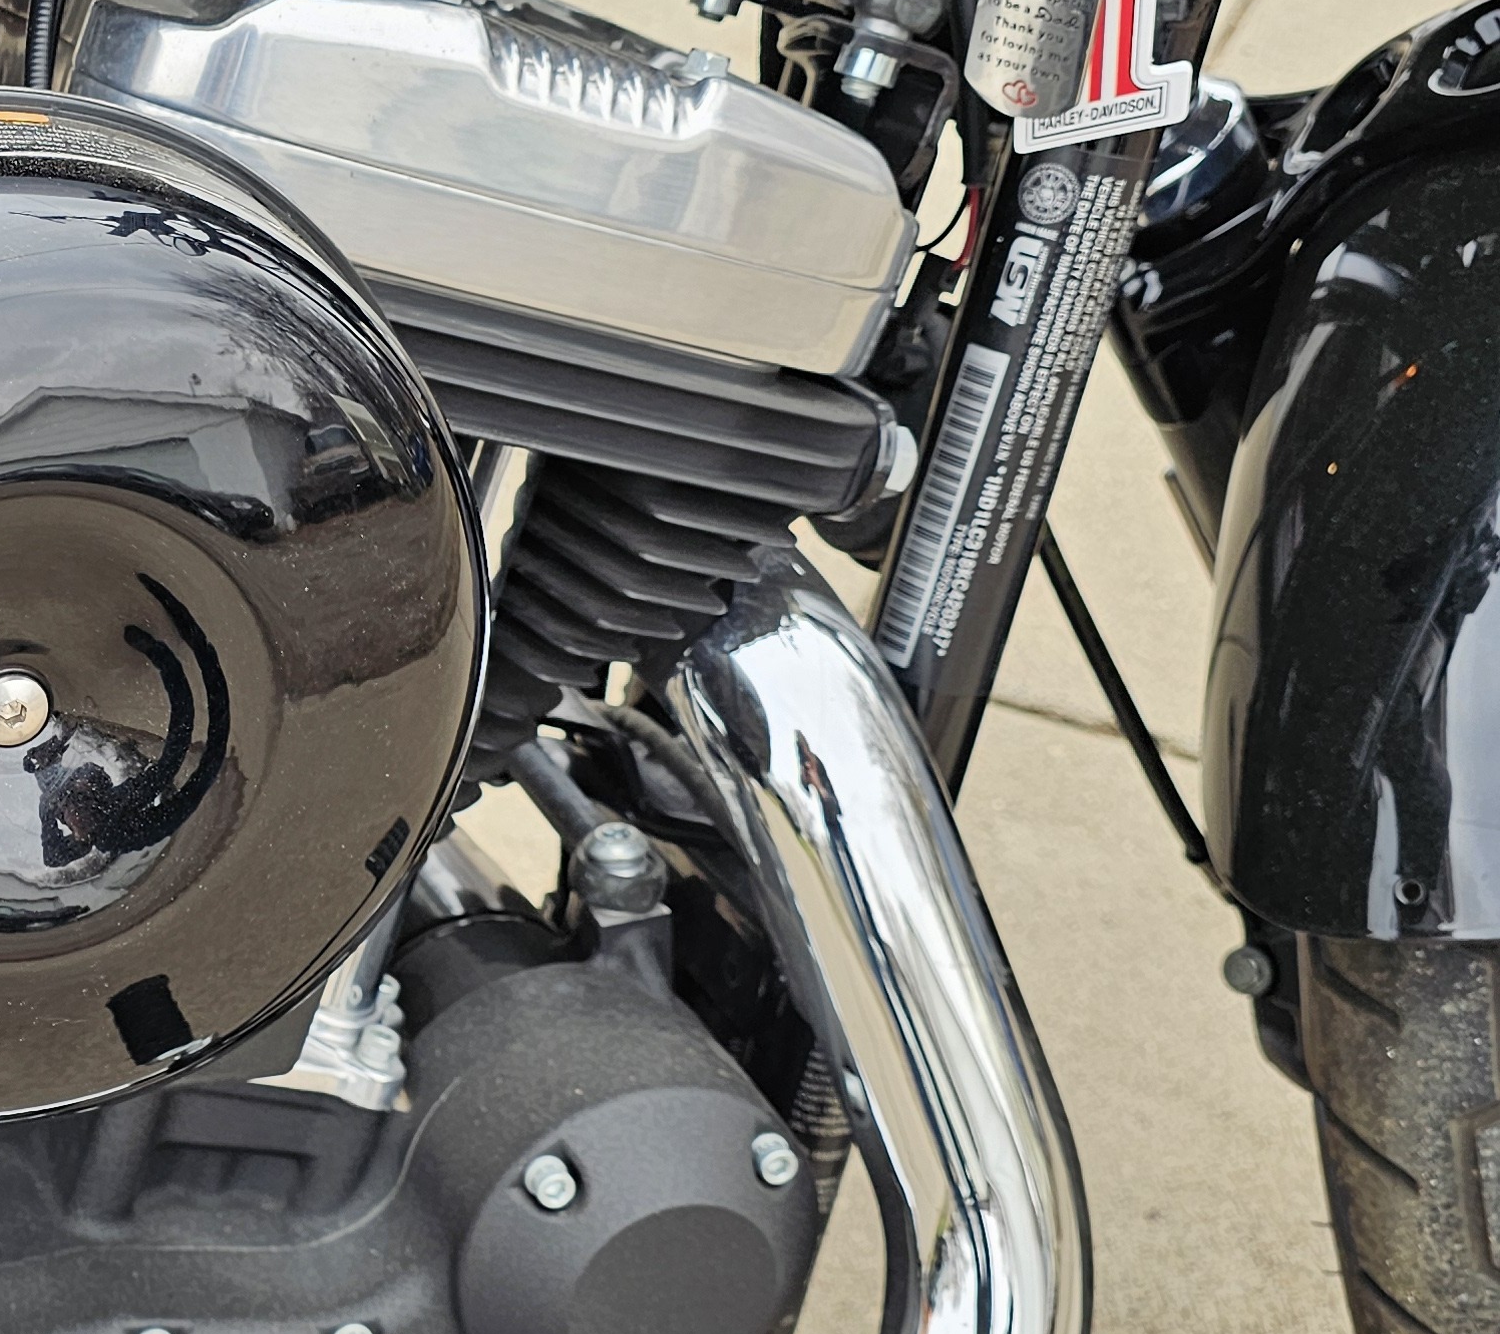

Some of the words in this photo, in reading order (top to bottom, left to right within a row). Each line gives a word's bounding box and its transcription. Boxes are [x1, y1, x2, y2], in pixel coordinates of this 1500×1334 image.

[1024, 5, 1031, 14] a
[980, 30, 998, 44] for
[1003, 37, 1044, 60] loving
[1049, 52, 1070, 63] me
[995, 16, 1034, 35] Thank
[1037, 31, 1064, 45] you
[977, 52, 991, 63] as
[996, 57, 1027, 72] your
[1031, 67, 1060, 81] own
[1079, 174, 1102, 199] THE
[1084, 176, 1116, 230] VEHICLE
[1106, 179, 1127, 206] THIS
[1067, 201, 1093, 234] DATE
[1087, 208, 1118, 261] VEHICLE
[1061, 235, 1081, 252] OF
[1068, 231, 1097, 277] SAFETY
[989, 235, 1045, 327] USW
[1064, 263, 1099, 332] CONFORMS
[1029, 255, 1075, 345] MANUFACTURE
[1043, 279, 1081, 352] STANDARDS
[1038, 353, 1055, 367] IN
[1058, 334, 1075, 350] TO
[1014, 346, 1043, 390] SHOWN
[1050, 352, 1069, 372] ALL
[1022, 368, 1051, 412] EFFECT
[1000, 393, 1028, 433] ABOVE
[1015, 414, 1035, 433] ON
[1025, 377, 1062, 447] APPLICABLE
[1018, 449, 1037, 466] US
[1000, 468, 1031, 520] FEDERAL
[985, 522, 1014, 564] MOTOR
